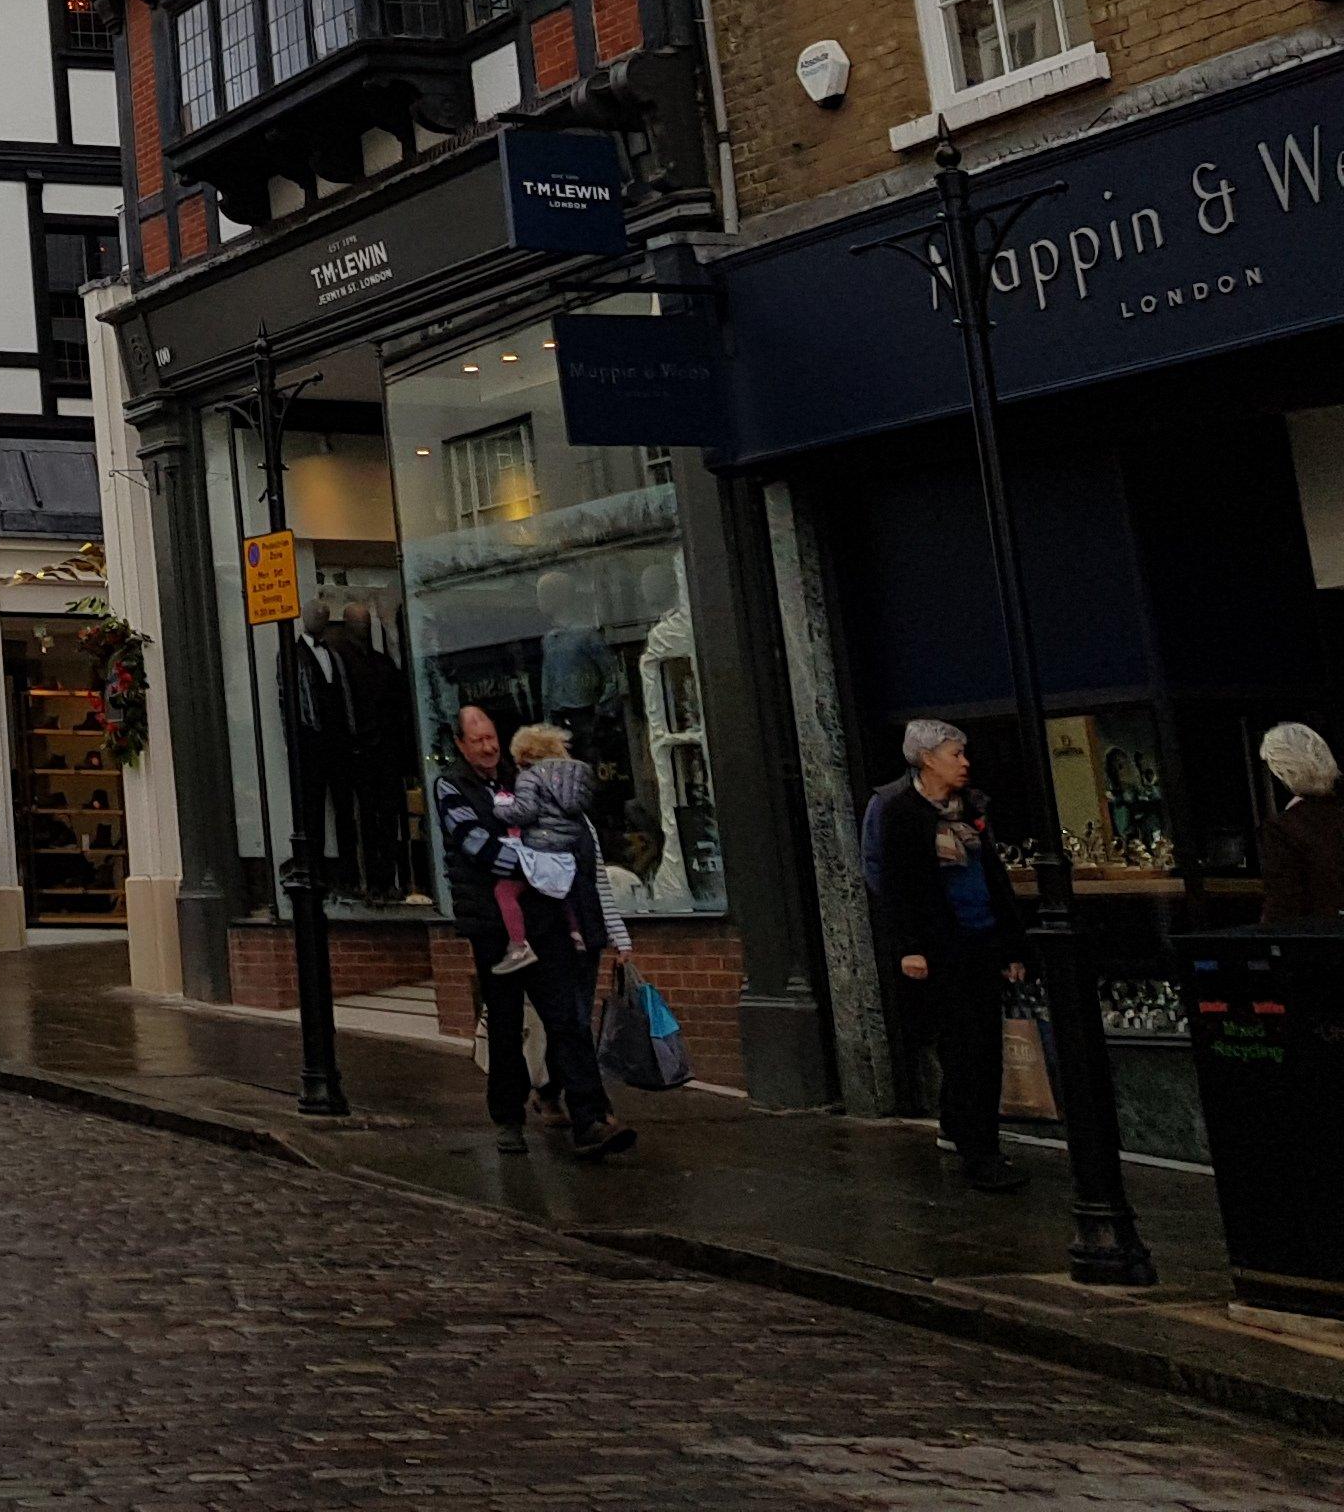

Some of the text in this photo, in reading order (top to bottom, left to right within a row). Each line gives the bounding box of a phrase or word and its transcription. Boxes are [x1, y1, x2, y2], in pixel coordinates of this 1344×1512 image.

[549, 200, 588, 210] LONDON
[1192, 162, 1237, 235] &
[359, 268, 394, 290] LONDON
[1121, 266, 1264, 319] LONDON
